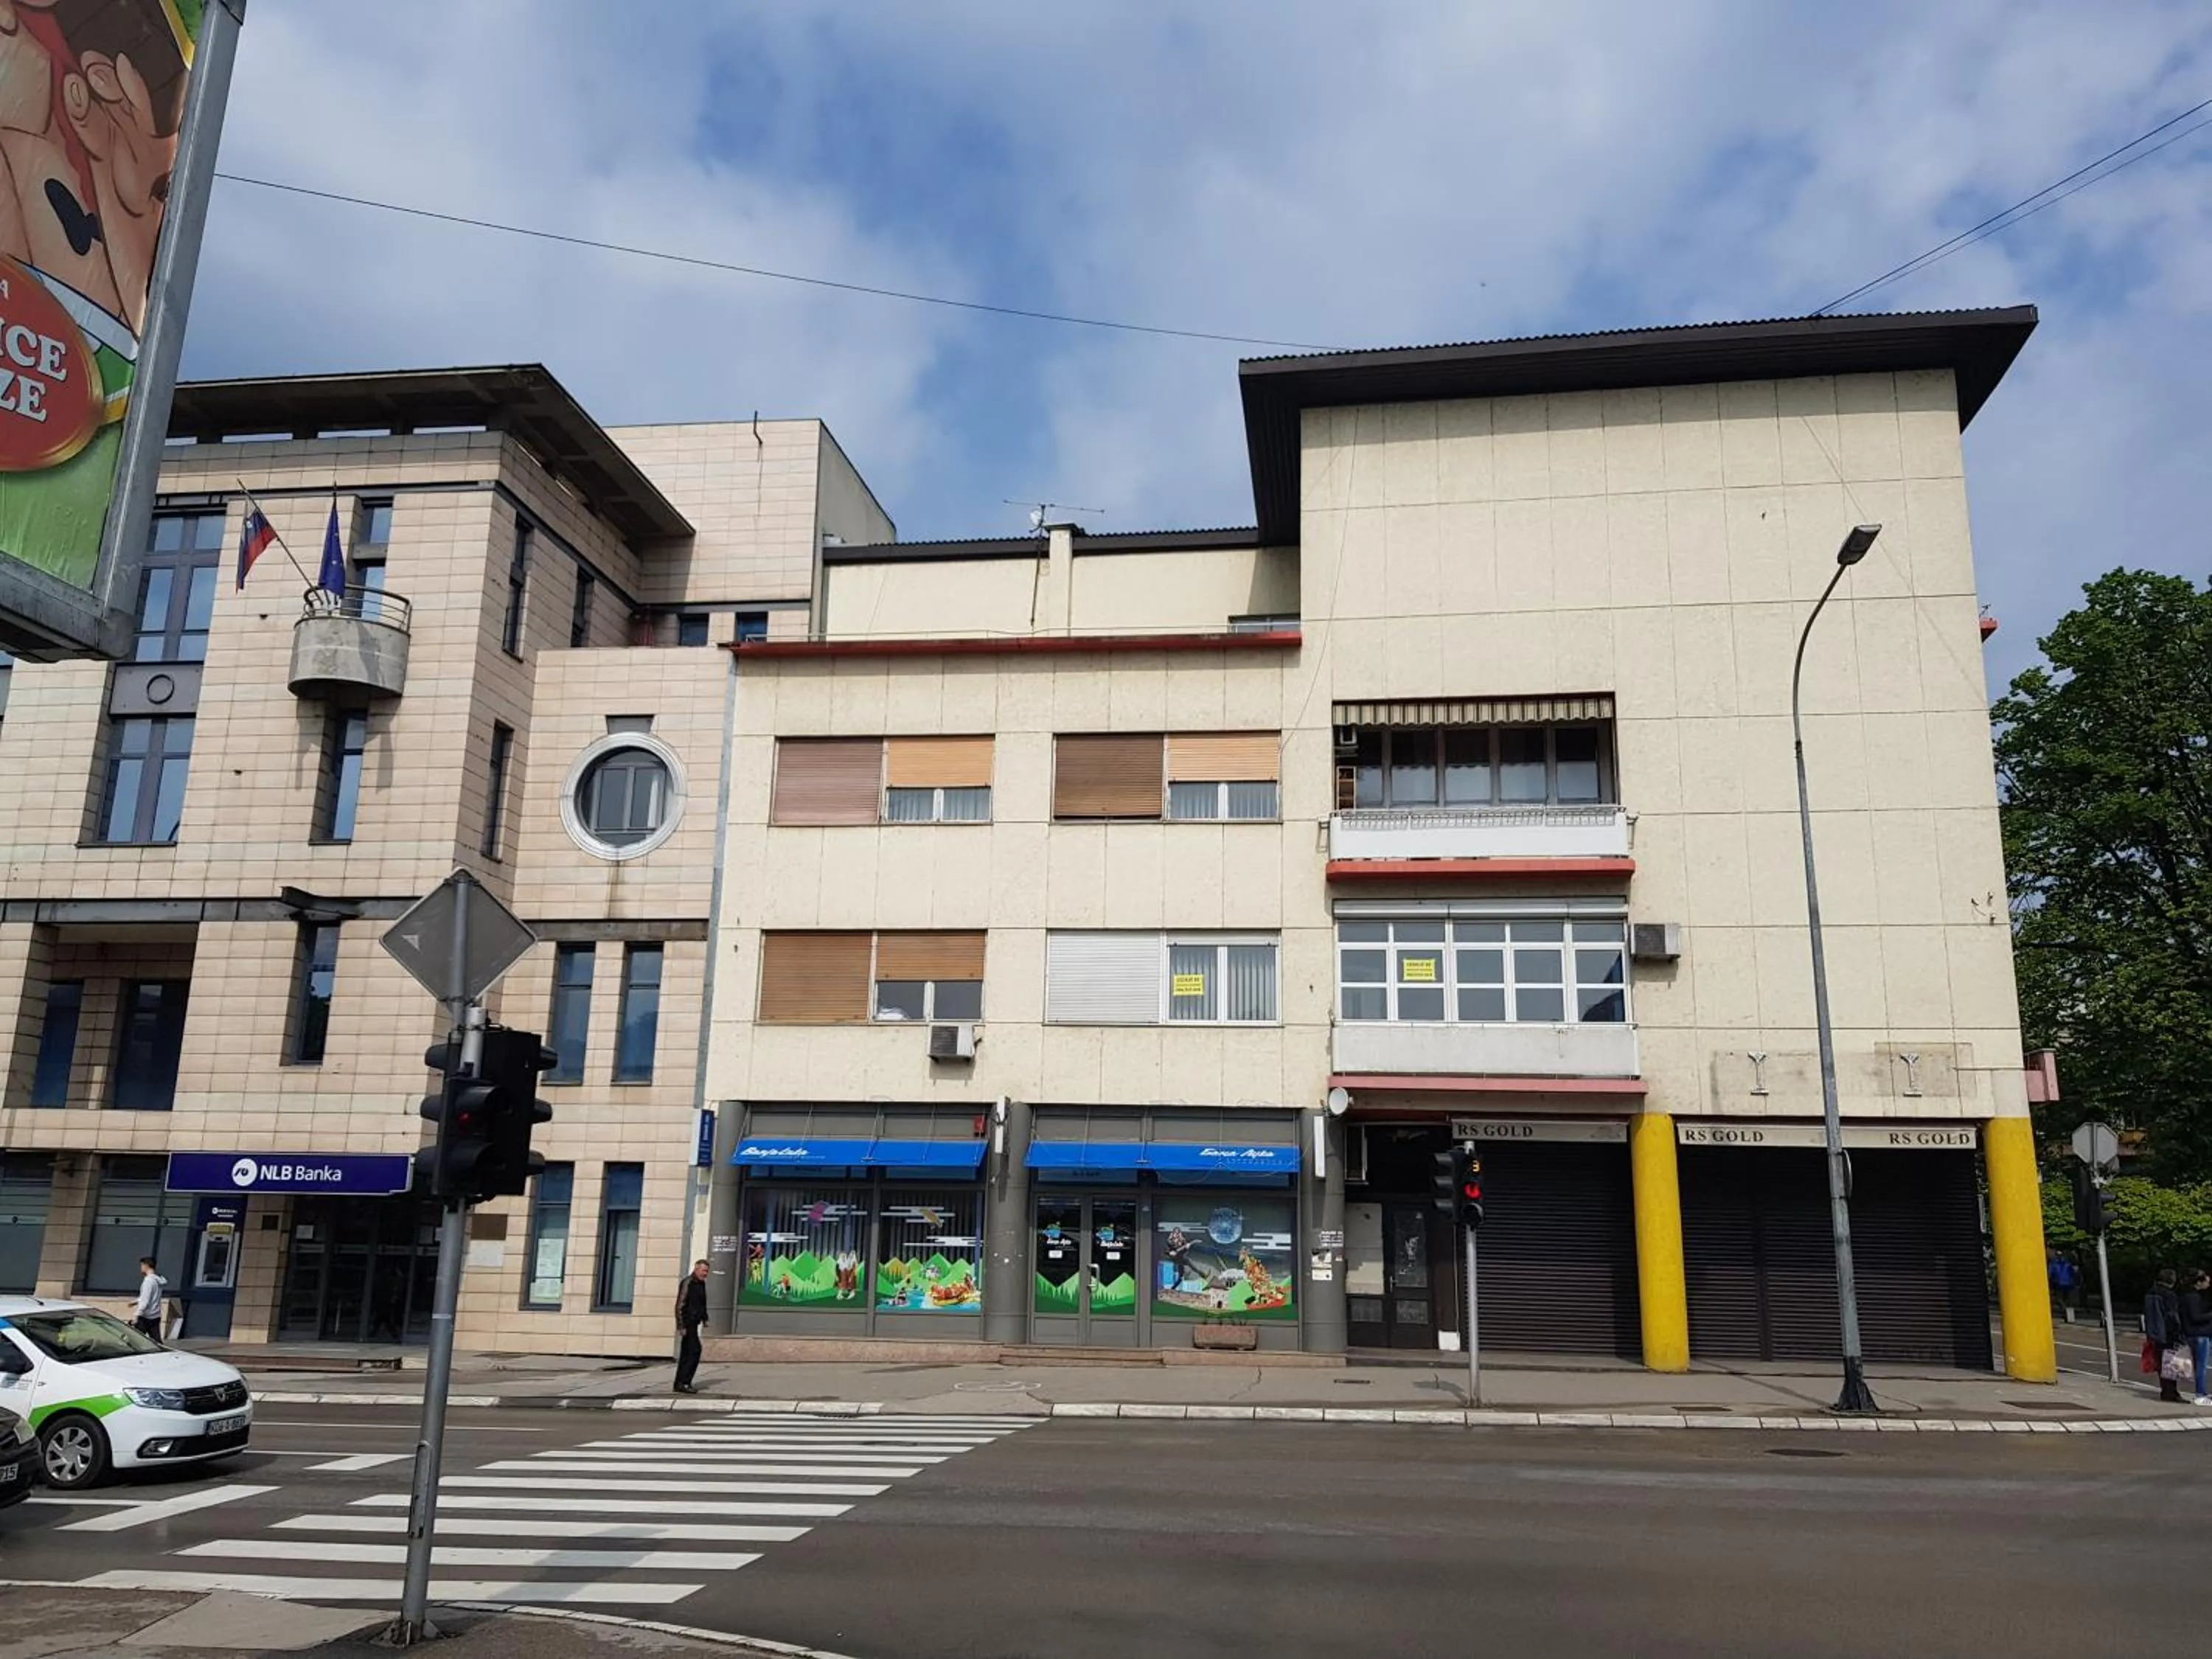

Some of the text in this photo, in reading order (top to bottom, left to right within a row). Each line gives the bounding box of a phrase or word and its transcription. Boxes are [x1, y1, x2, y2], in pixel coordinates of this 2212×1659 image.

[1458, 1124, 1534, 1137] RS GOLD
[1686, 1129, 1764, 1142] RS GOLD
[1889, 1133, 1970, 1145] RS GOLD
[260, 1164, 343, 1181] NLB Banka
[1472, 1160, 1481, 1172] 3
